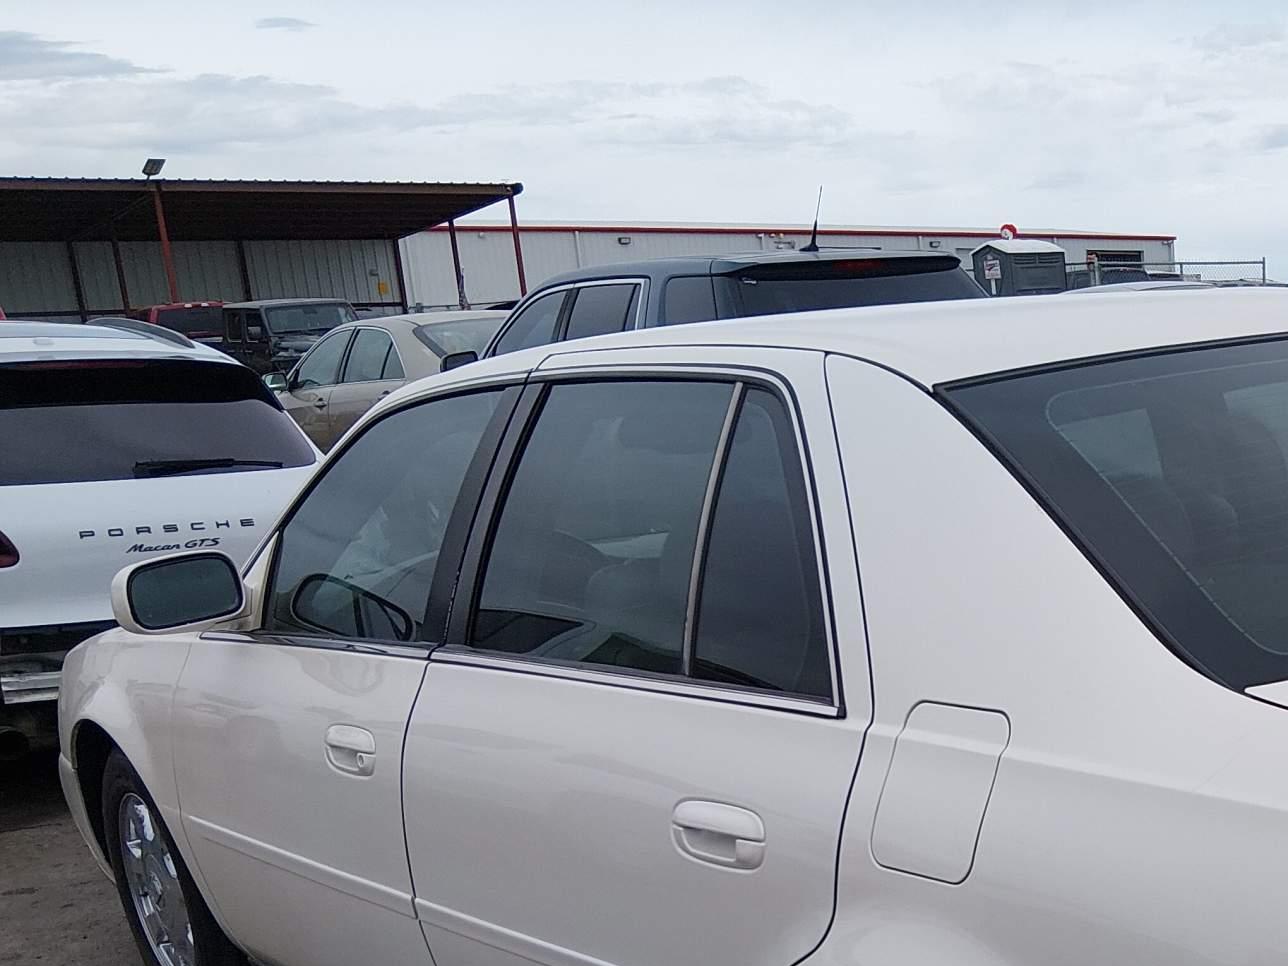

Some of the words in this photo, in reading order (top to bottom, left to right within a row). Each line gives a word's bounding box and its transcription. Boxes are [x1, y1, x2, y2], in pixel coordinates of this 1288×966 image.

[79, 518, 255, 540] PORSCHE
[126, 543, 181, 554] Macan
[183, 537, 221, 549] GTS
